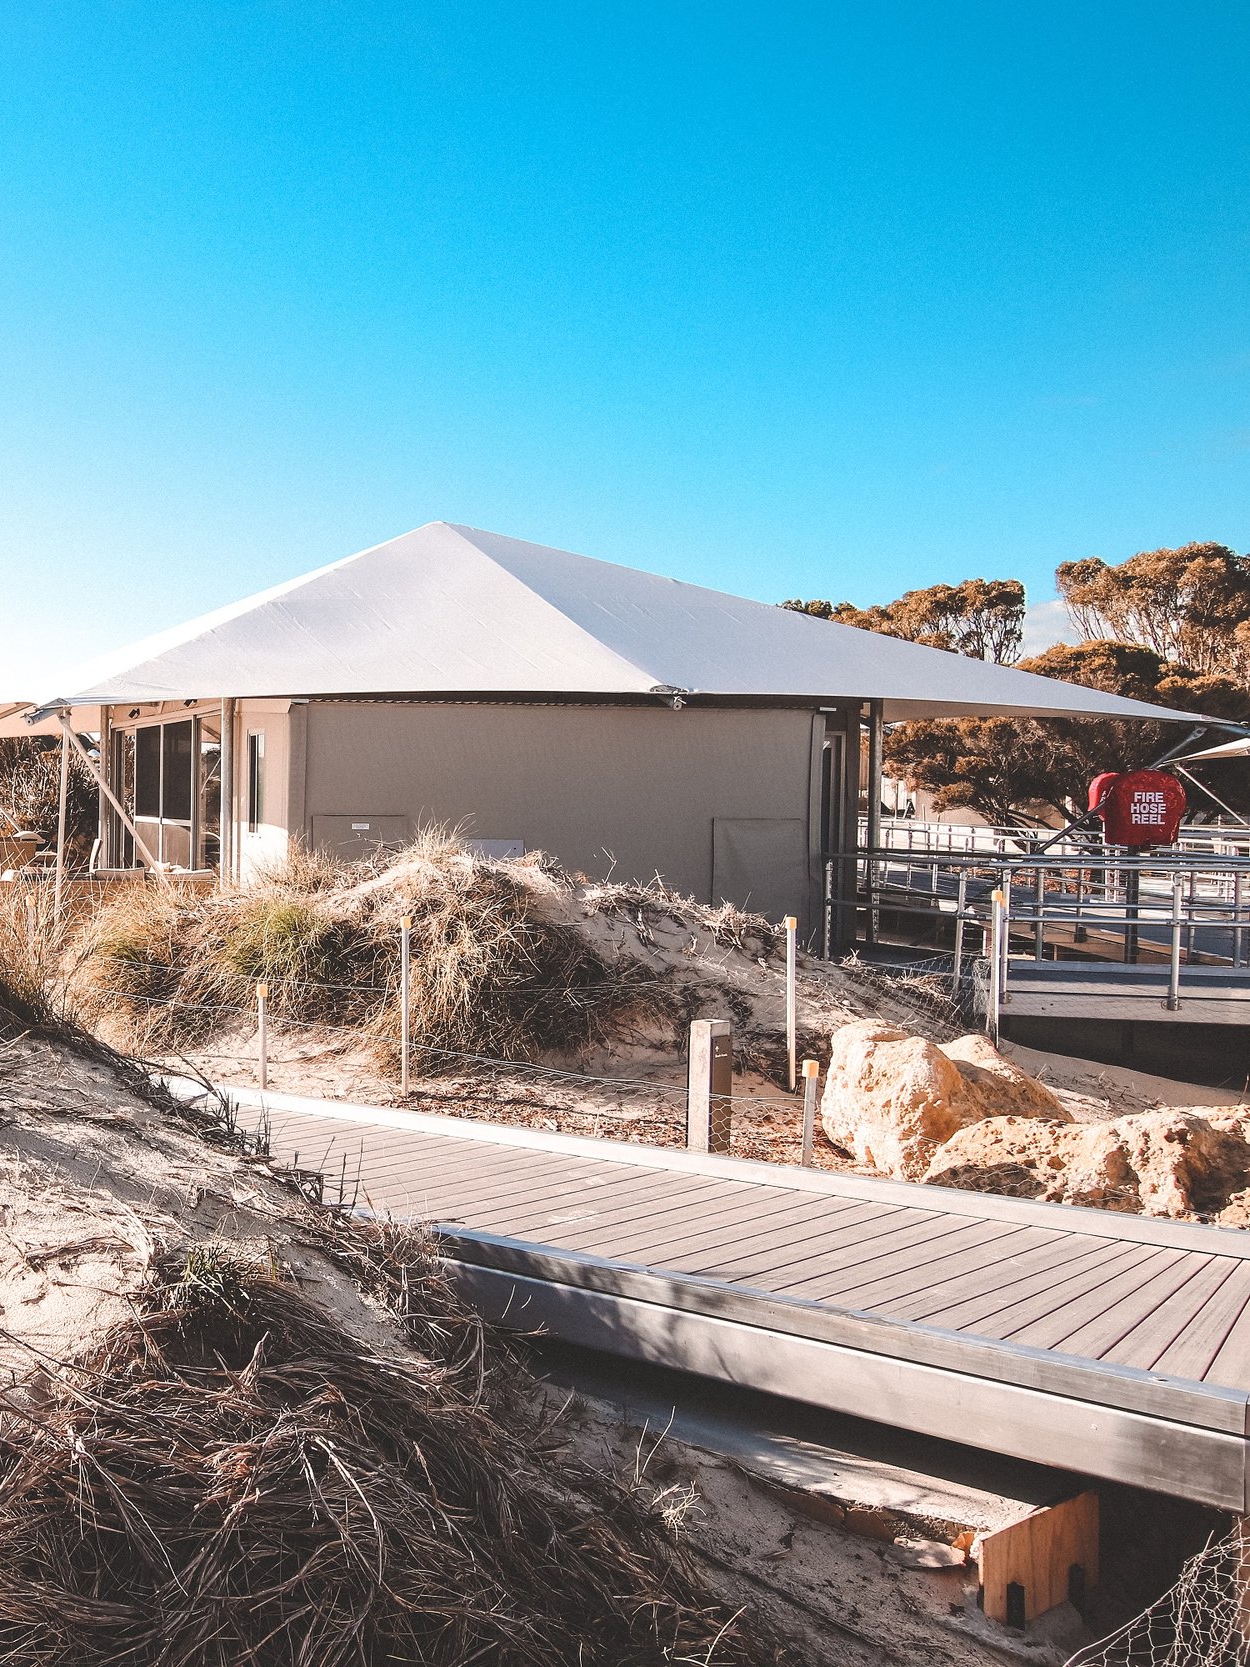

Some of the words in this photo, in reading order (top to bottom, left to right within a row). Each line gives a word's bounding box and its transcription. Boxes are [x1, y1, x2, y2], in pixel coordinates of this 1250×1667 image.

[1134, 792, 1164, 803] FIRE
[1131, 803, 1167, 814] HOSE
[1132, 814, 1166, 825] REEL
